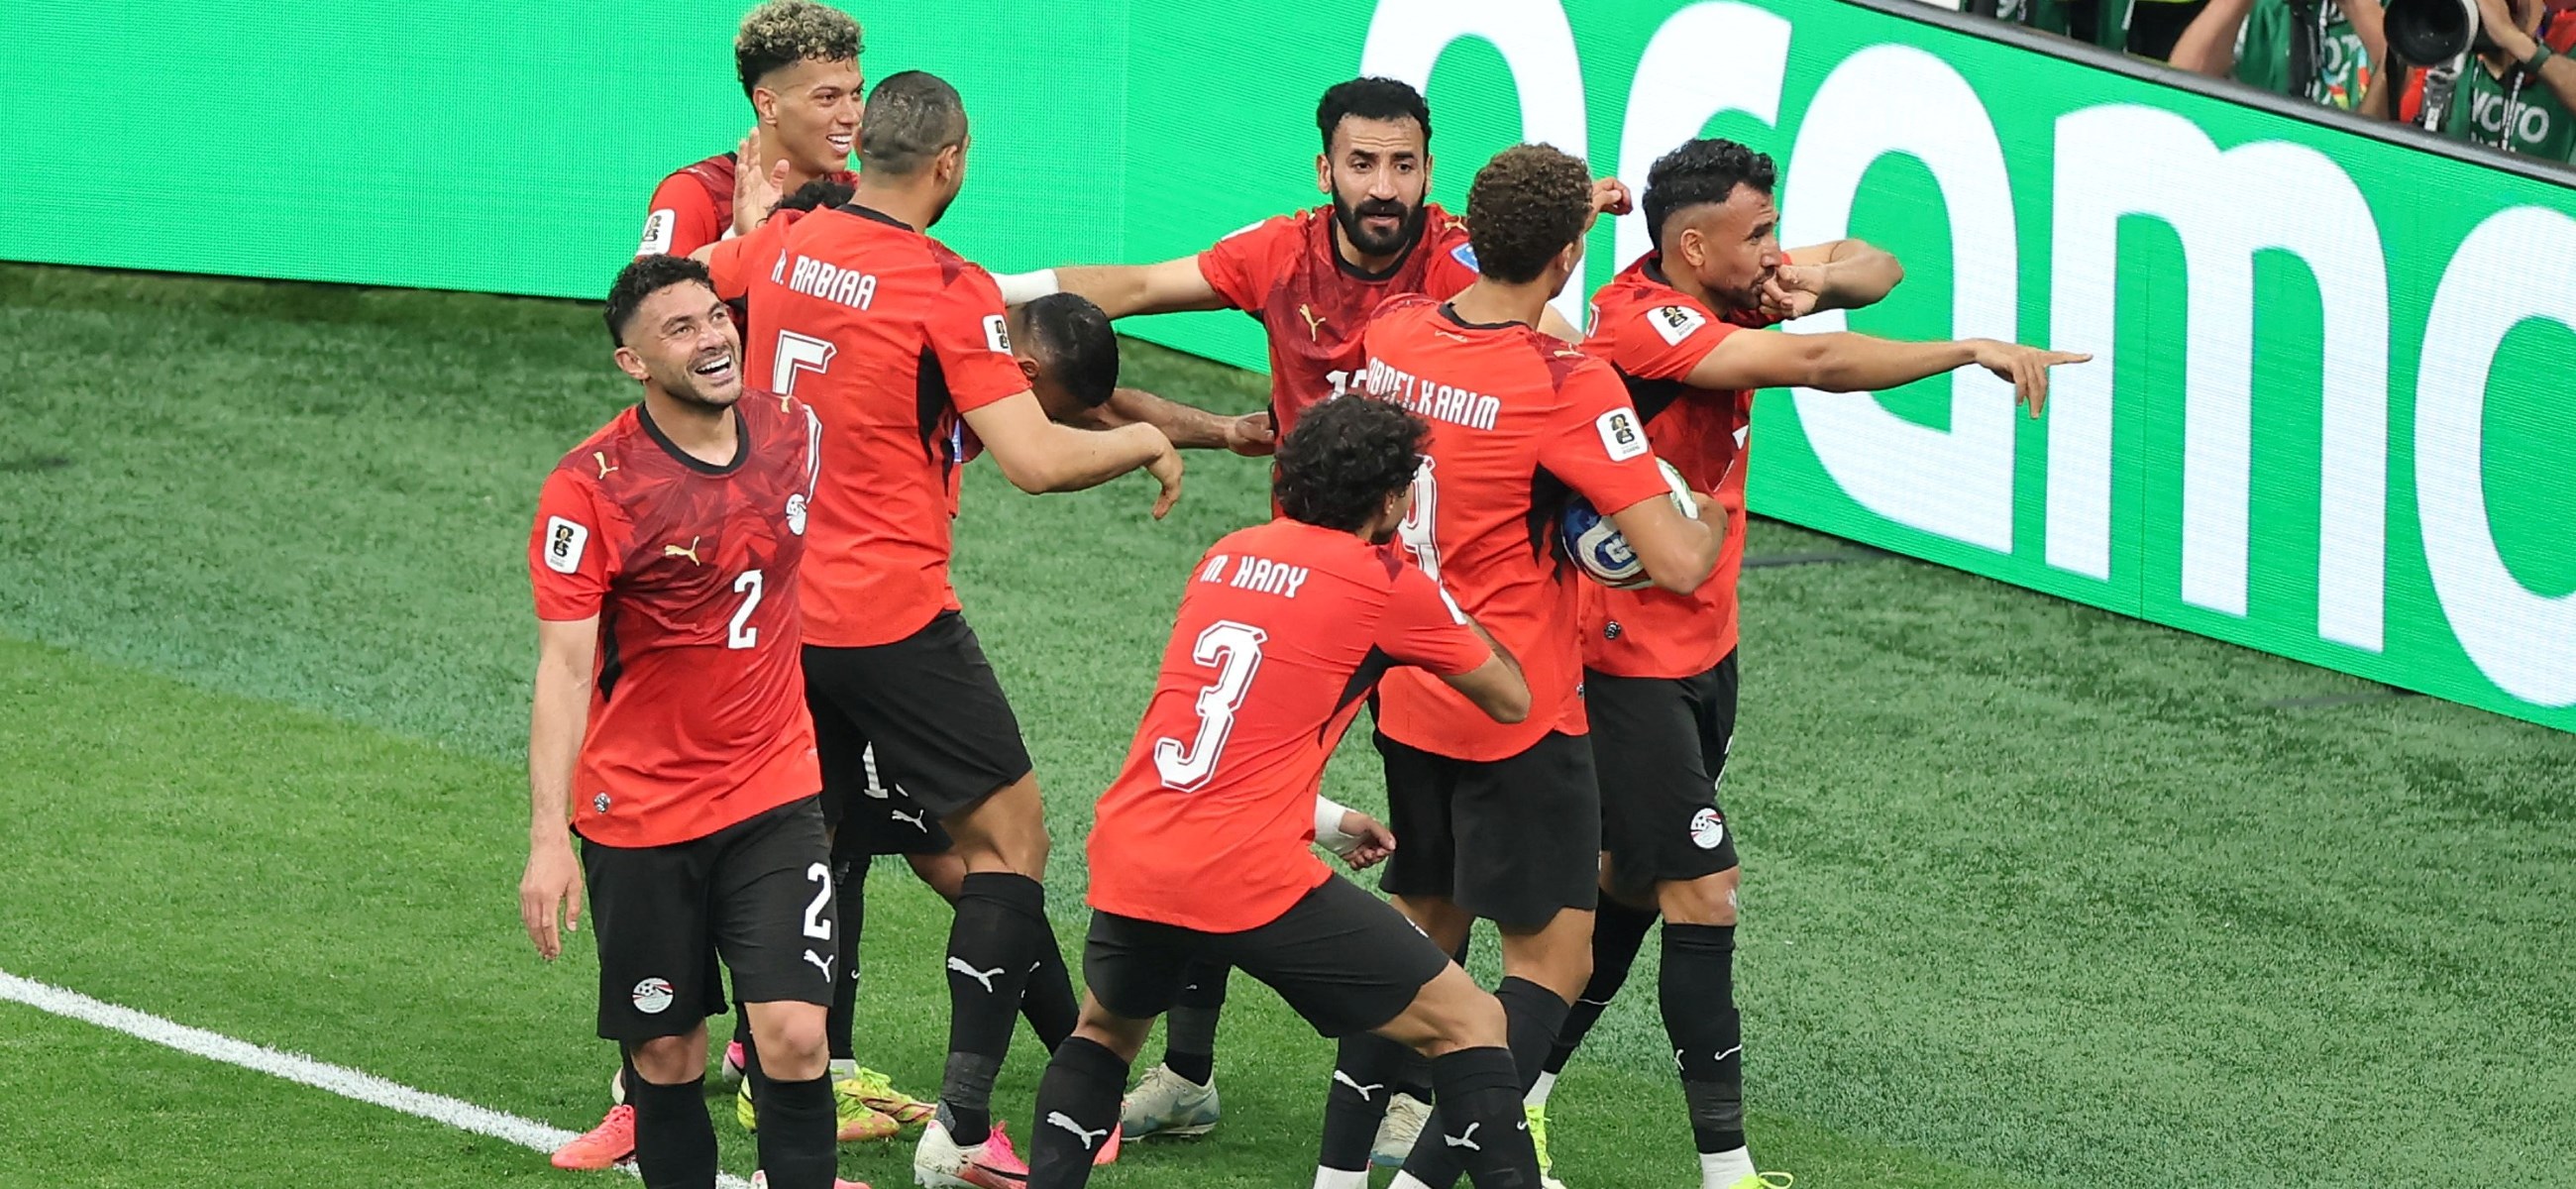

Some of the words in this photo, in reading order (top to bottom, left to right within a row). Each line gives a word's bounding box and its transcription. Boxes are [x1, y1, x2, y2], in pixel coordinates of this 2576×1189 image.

[789, 255, 878, 311] RABIAA
[727, 569, 763, 650] 2
[1199, 555, 1229, 584] M.
[1230, 555, 1309, 598] HANY
[1154, 619, 1268, 794] 3
[803, 861, 831, 940] 2
